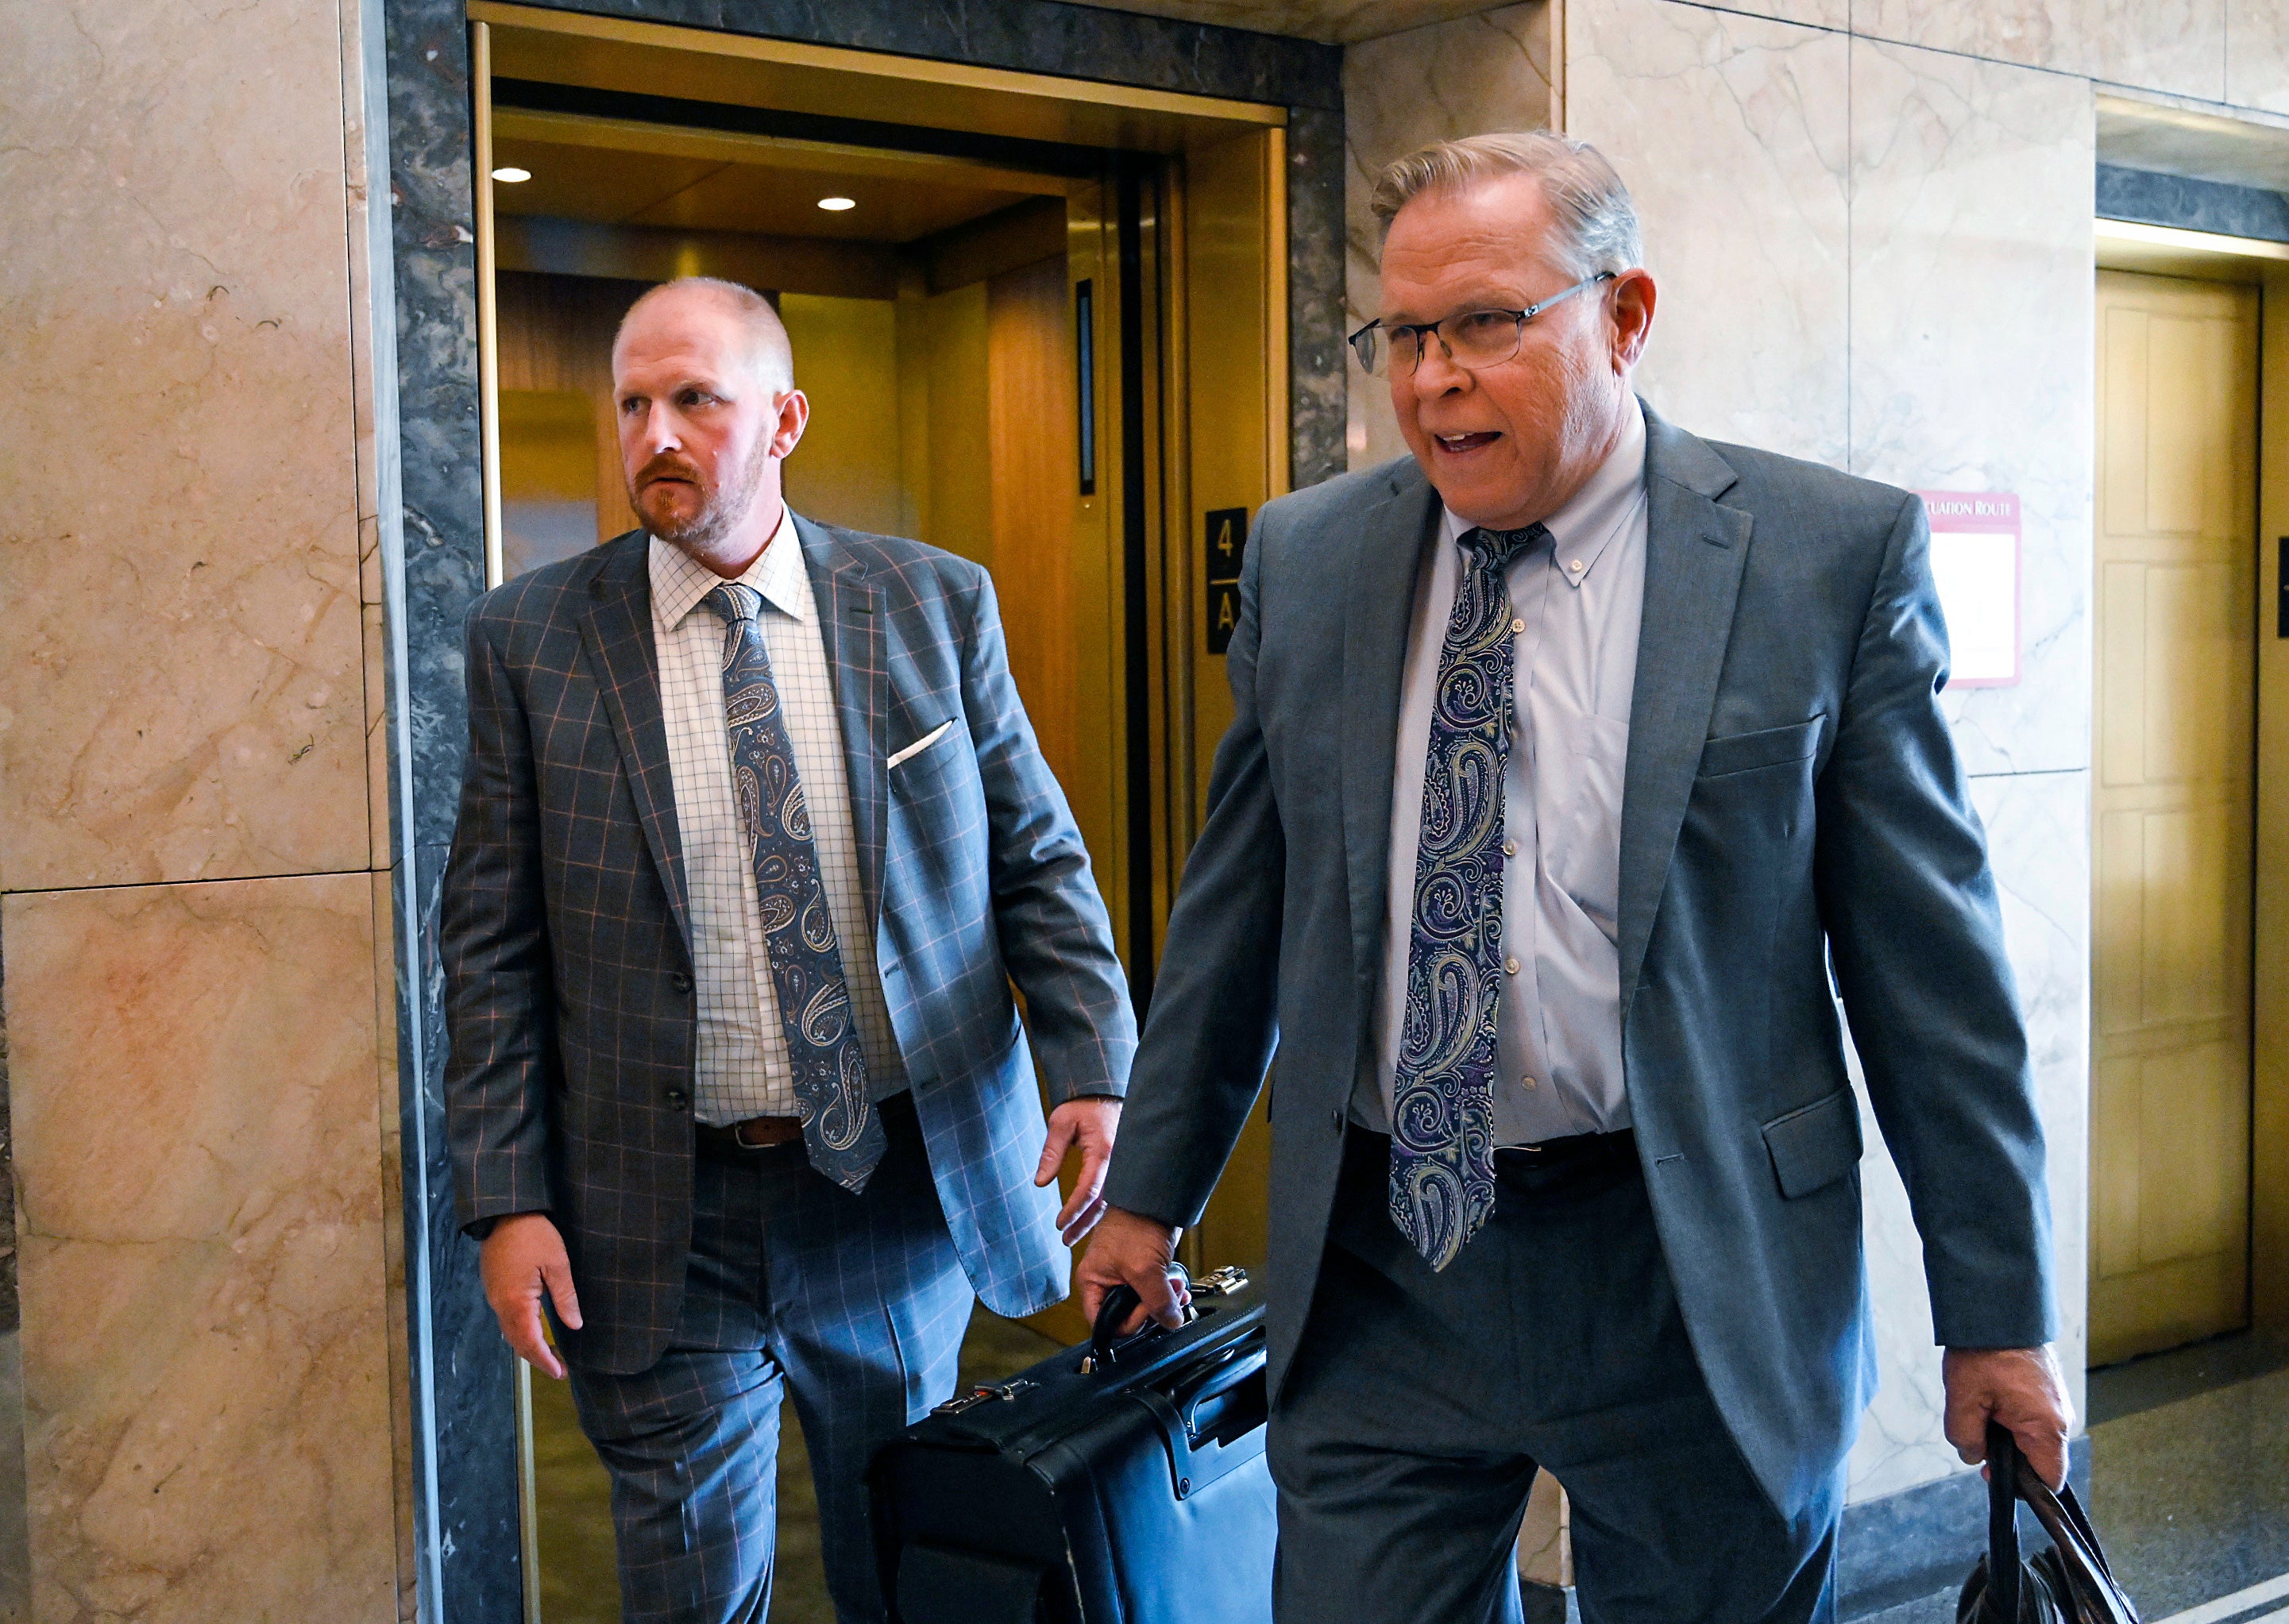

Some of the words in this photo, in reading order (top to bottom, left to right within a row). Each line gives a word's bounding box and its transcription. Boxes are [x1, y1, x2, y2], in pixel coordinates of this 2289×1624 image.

[1925, 502, 1972, 515] UATION
[1218, 519, 1233, 557] 4
[1218, 592, 1234, 631] A
